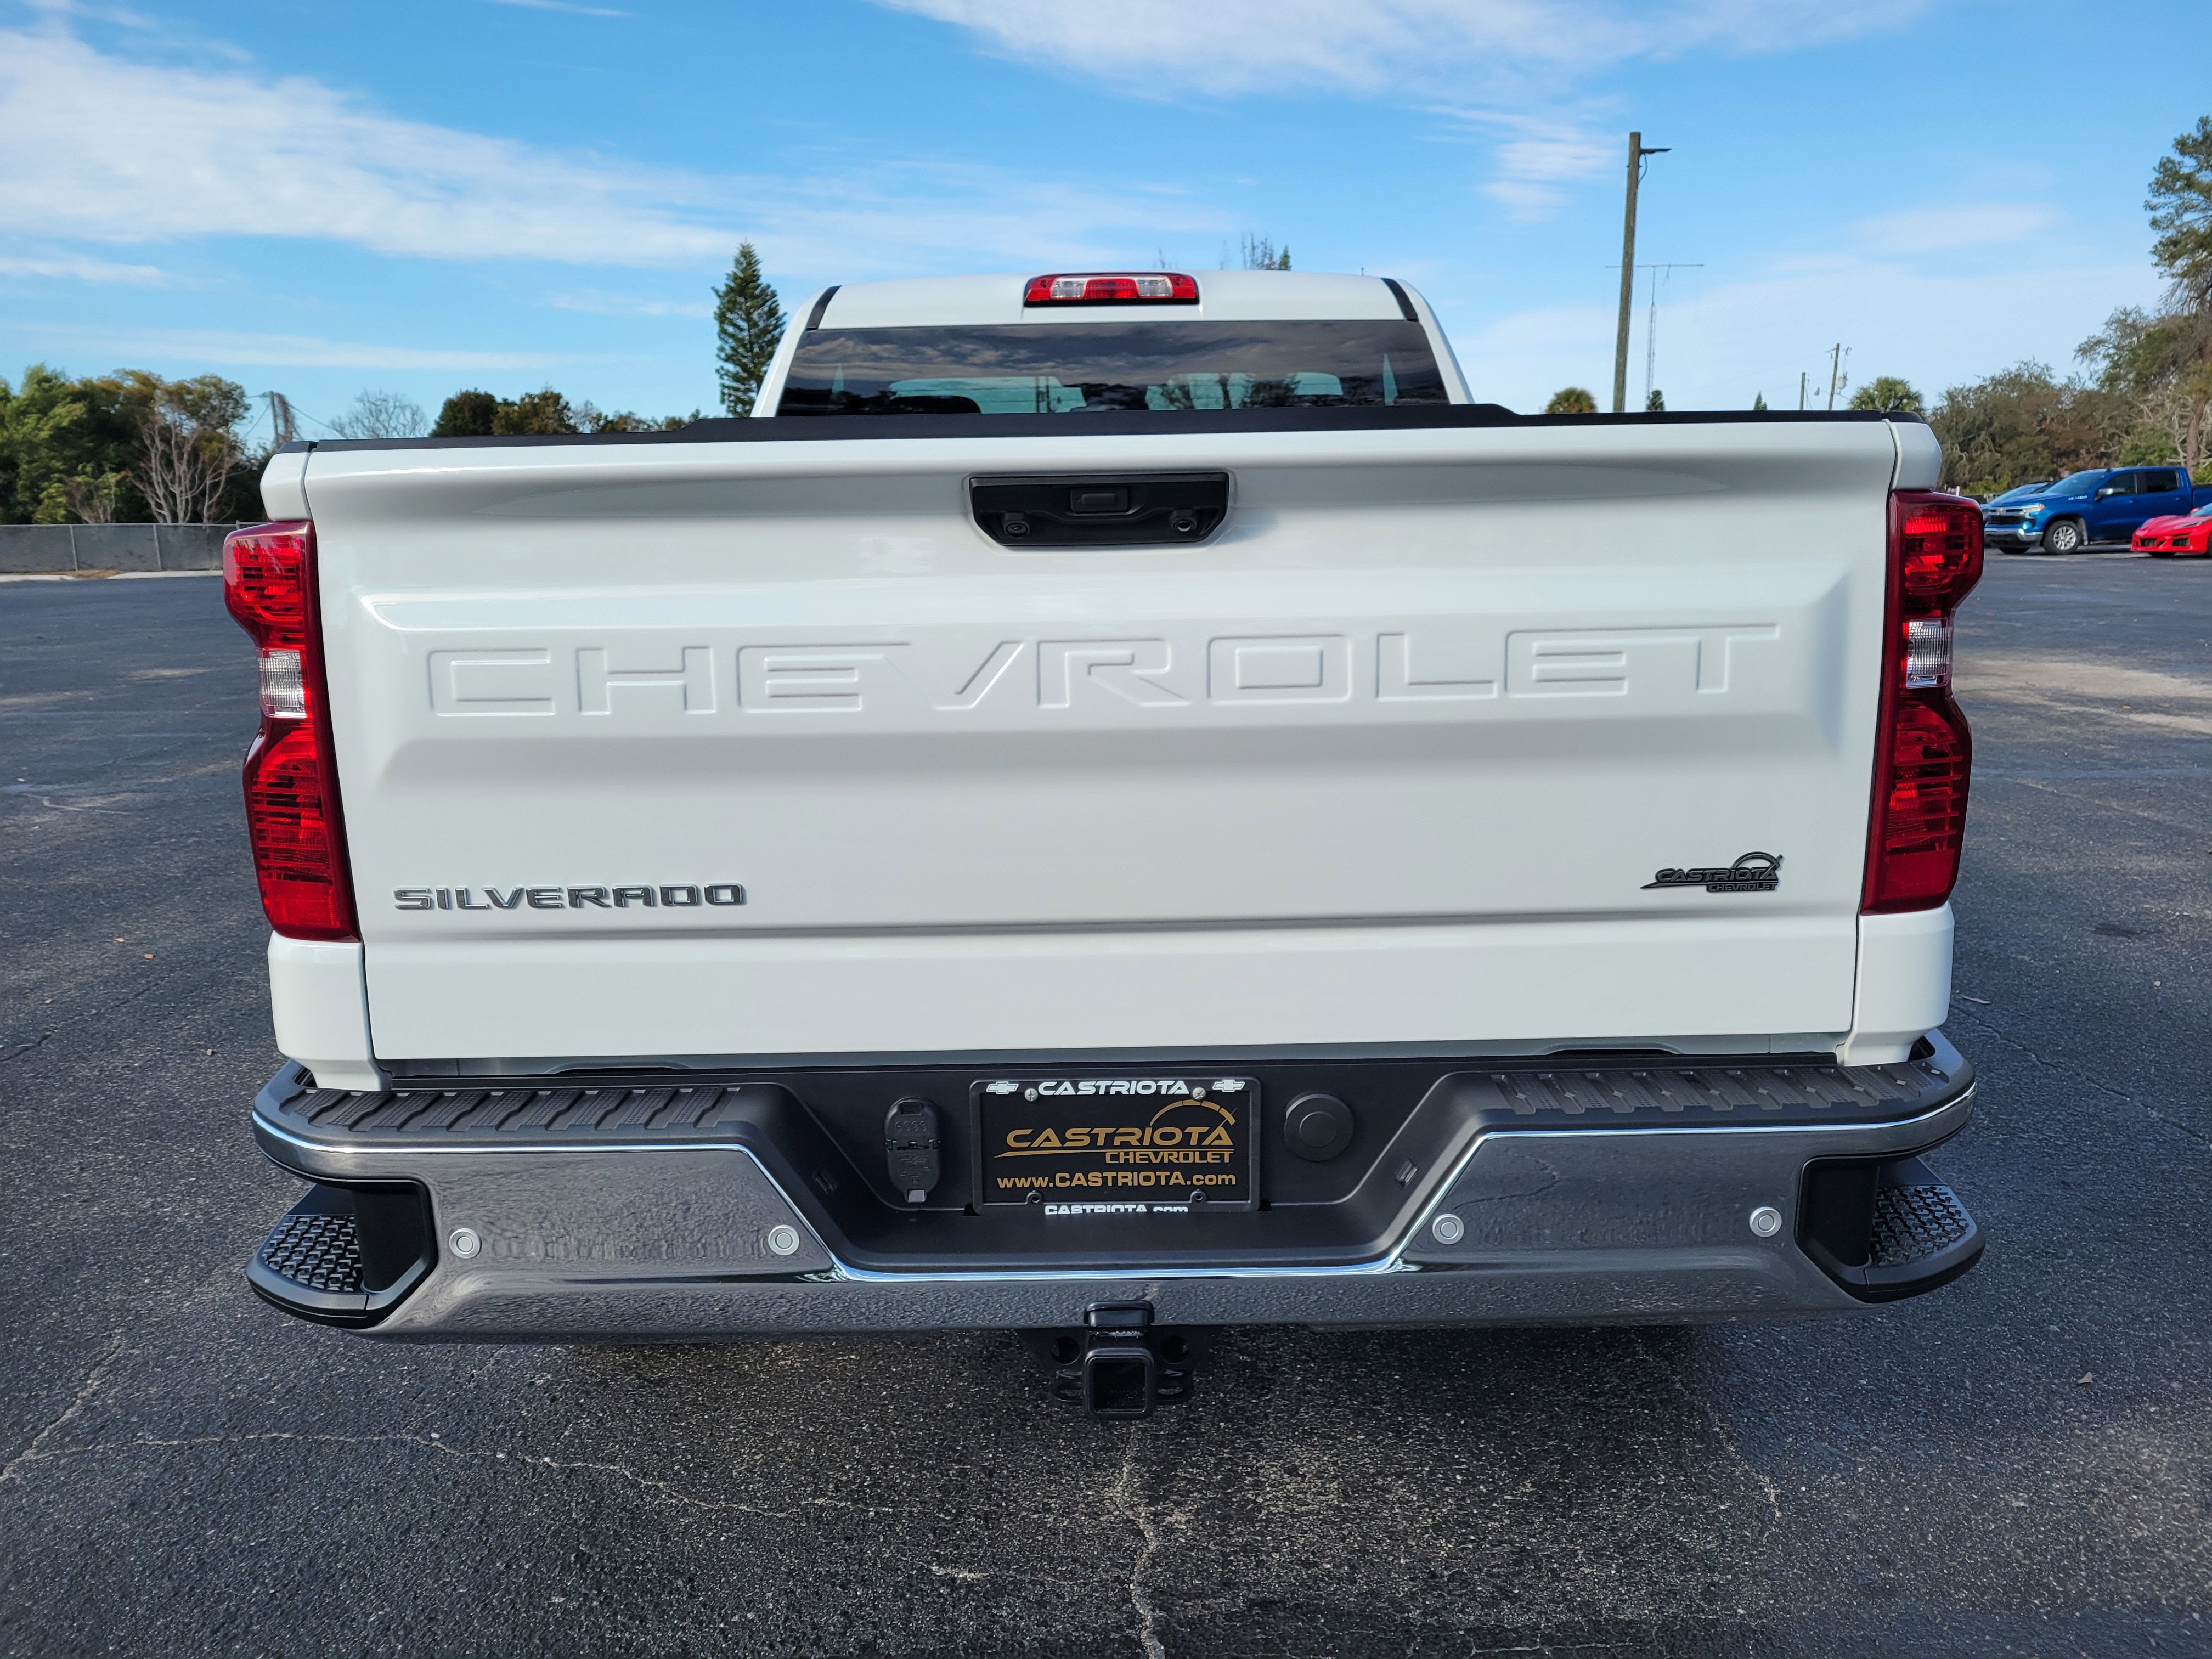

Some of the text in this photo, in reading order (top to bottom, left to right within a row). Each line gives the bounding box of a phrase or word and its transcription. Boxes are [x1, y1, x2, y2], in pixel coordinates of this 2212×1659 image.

[427, 623, 1780, 717] CHEVROLET
[1655, 867, 1779, 882] CASTRIOTA
[1707, 883, 1776, 891] CHEVROLET
[393, 883, 744, 911] SILVERADO
[1037, 1080, 1189, 1096] CASTRIOTA
[1006, 1126, 1233, 1148] CASTRIOTA
[1105, 1151, 1233, 1164] CHEVROLET
[997, 1171, 1236, 1188] www.CASTRIOTA.com
